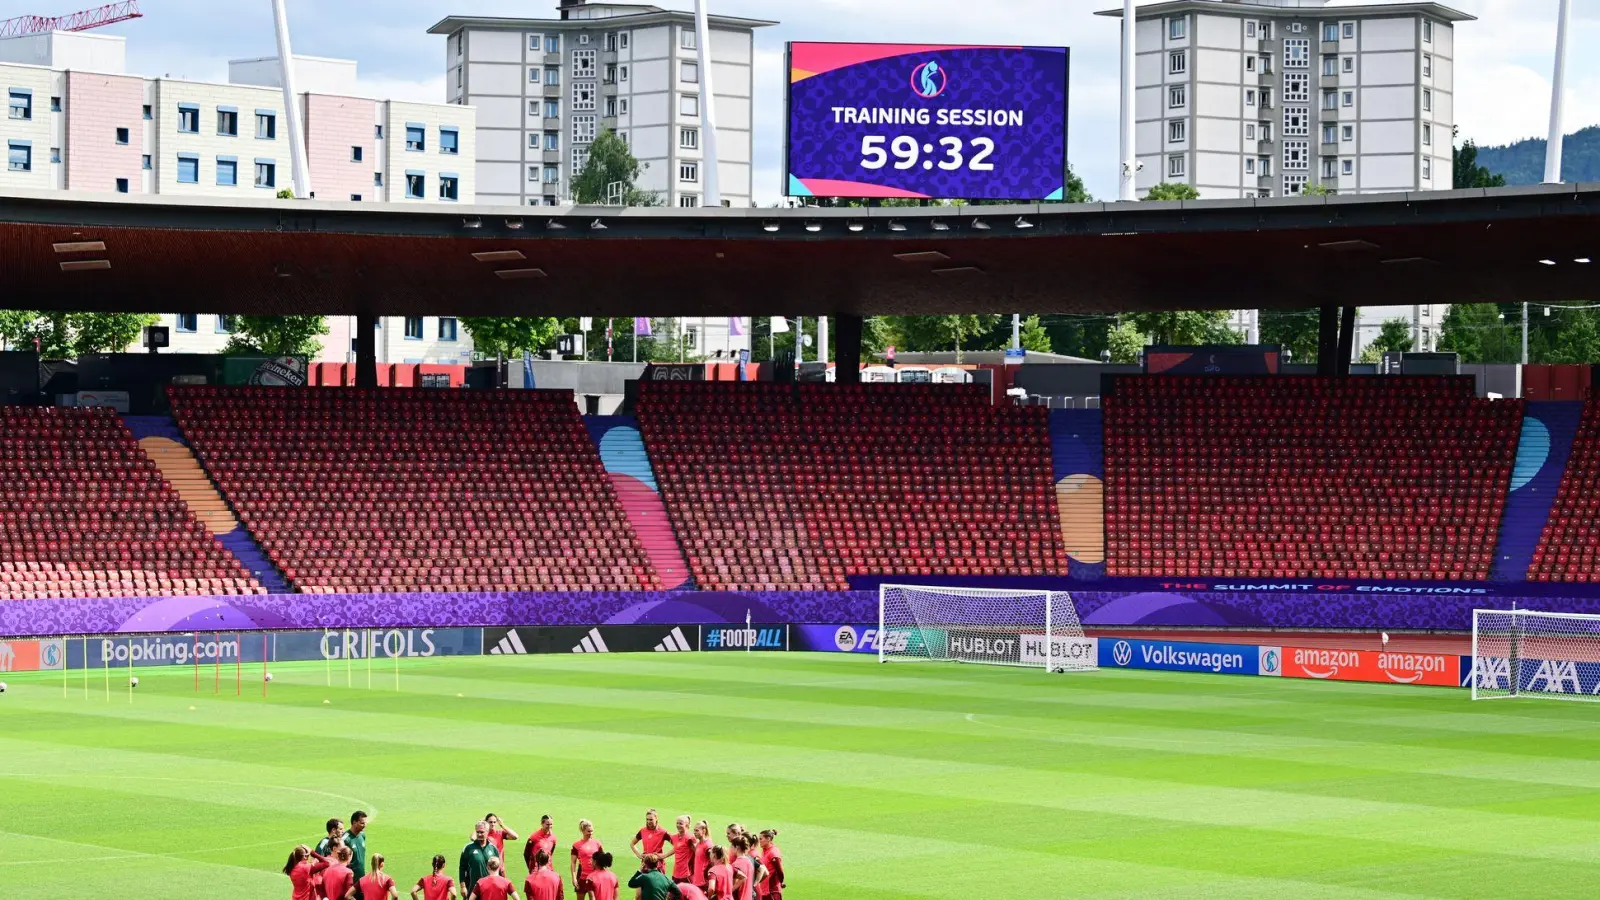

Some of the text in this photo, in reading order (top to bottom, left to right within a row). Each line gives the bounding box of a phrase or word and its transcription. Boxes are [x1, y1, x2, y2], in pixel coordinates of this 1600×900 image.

[831, 106, 1024, 126] TRAINING SESSION
[859, 135, 995, 171] 59:32
[262, 360, 303, 386] Heineken
[1213, 583, 1313, 591] SUMMIT
[1355, 585, 1487, 594] EMOTIONS
[320, 629, 436, 659] GRIFOLS
[706, 629, 782, 648] #FOOTBALL
[839, 631, 853, 640] EA
[951, 635, 1015, 655] HUBLOT
[101, 637, 238, 664] Booking.com
[1026, 640, 1093, 660] HUBLOT
[1141, 644, 1243, 672] Volkswagen
[1294, 648, 1359, 668] amazon
[1377, 652, 1445, 673] amazon
[1461, 656, 1512, 689] AXA
[1526, 659, 1582, 694] AXA
